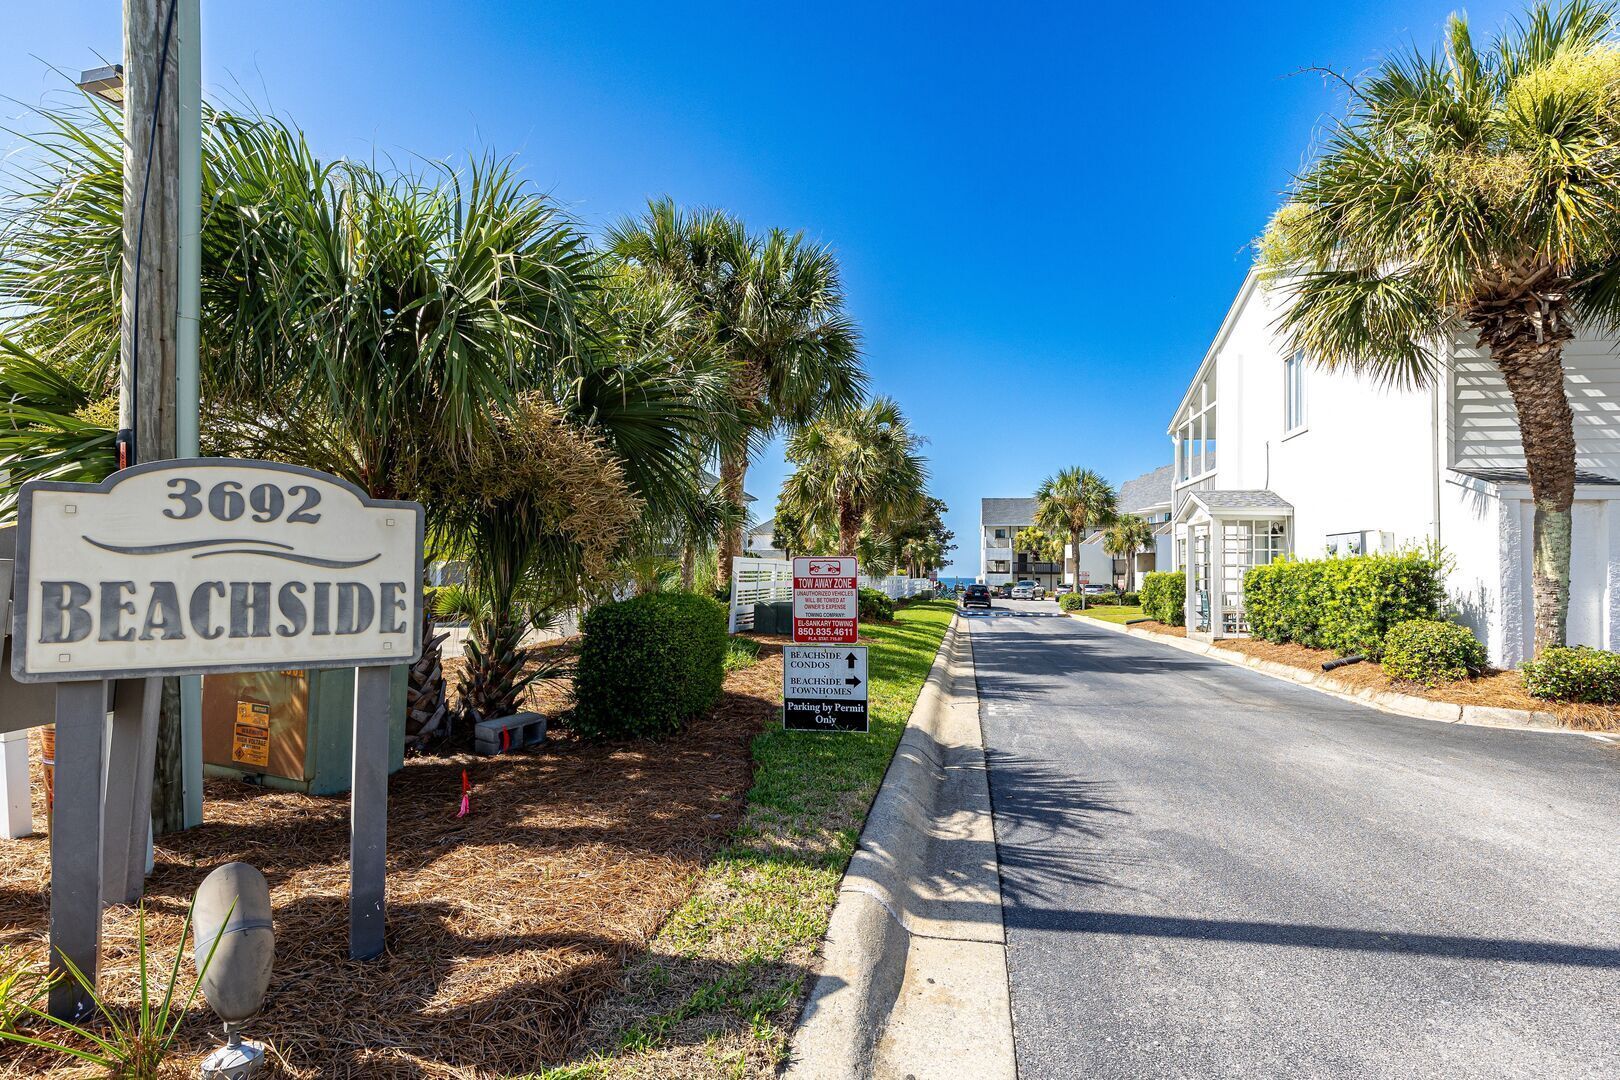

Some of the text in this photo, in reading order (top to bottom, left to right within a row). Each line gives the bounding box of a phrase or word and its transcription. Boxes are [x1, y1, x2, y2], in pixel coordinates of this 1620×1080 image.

[162, 478, 322, 524] 3692
[799, 578, 852, 588] TOW AWAY ZONE
[39, 581, 407, 644] BEACHSIDE
[788, 702, 864, 713] Parking by Permit
[816, 715, 836, 726] Only
